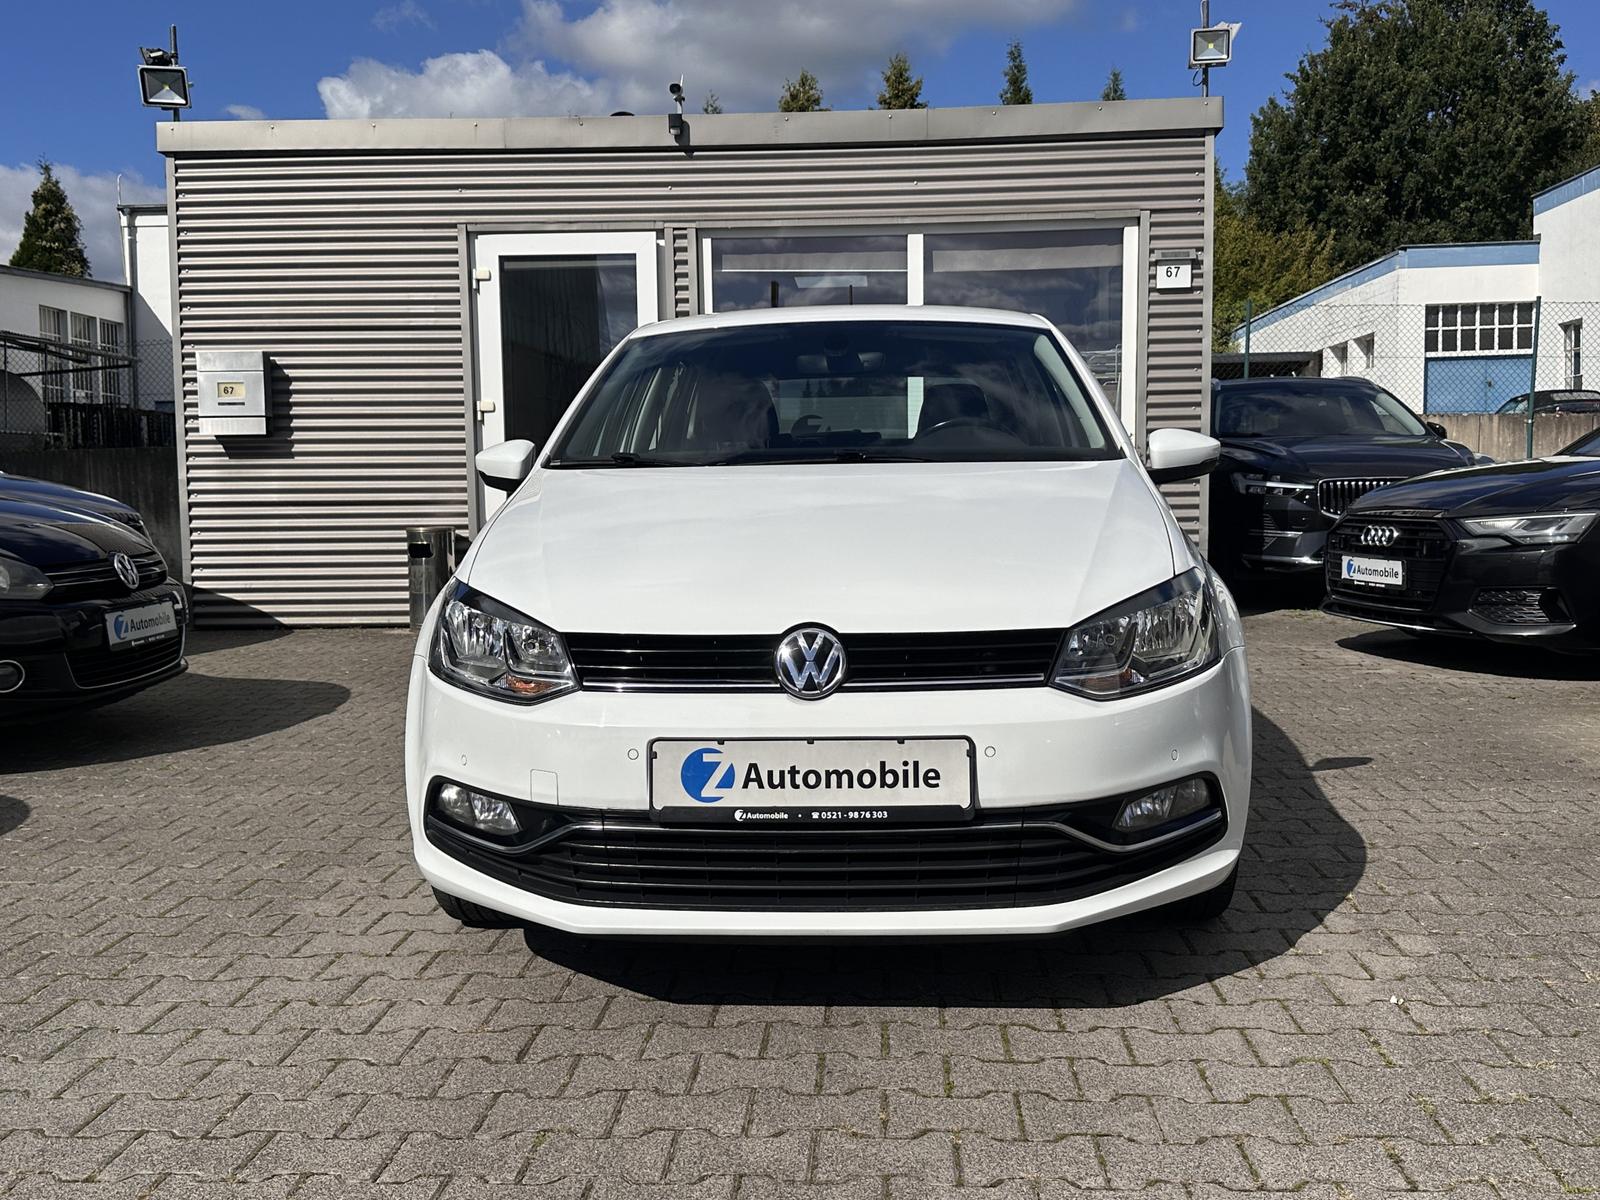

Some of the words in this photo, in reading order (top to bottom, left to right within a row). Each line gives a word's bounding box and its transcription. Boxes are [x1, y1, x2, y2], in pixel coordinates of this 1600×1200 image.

[1165, 266, 1181, 278] 67
[223, 386, 235, 395] 67
[1356, 565, 1399, 579] Automobile
[130, 612, 171, 632] Automobile
[742, 761, 941, 789] Automobile
[821, 811, 842, 819] 0521
